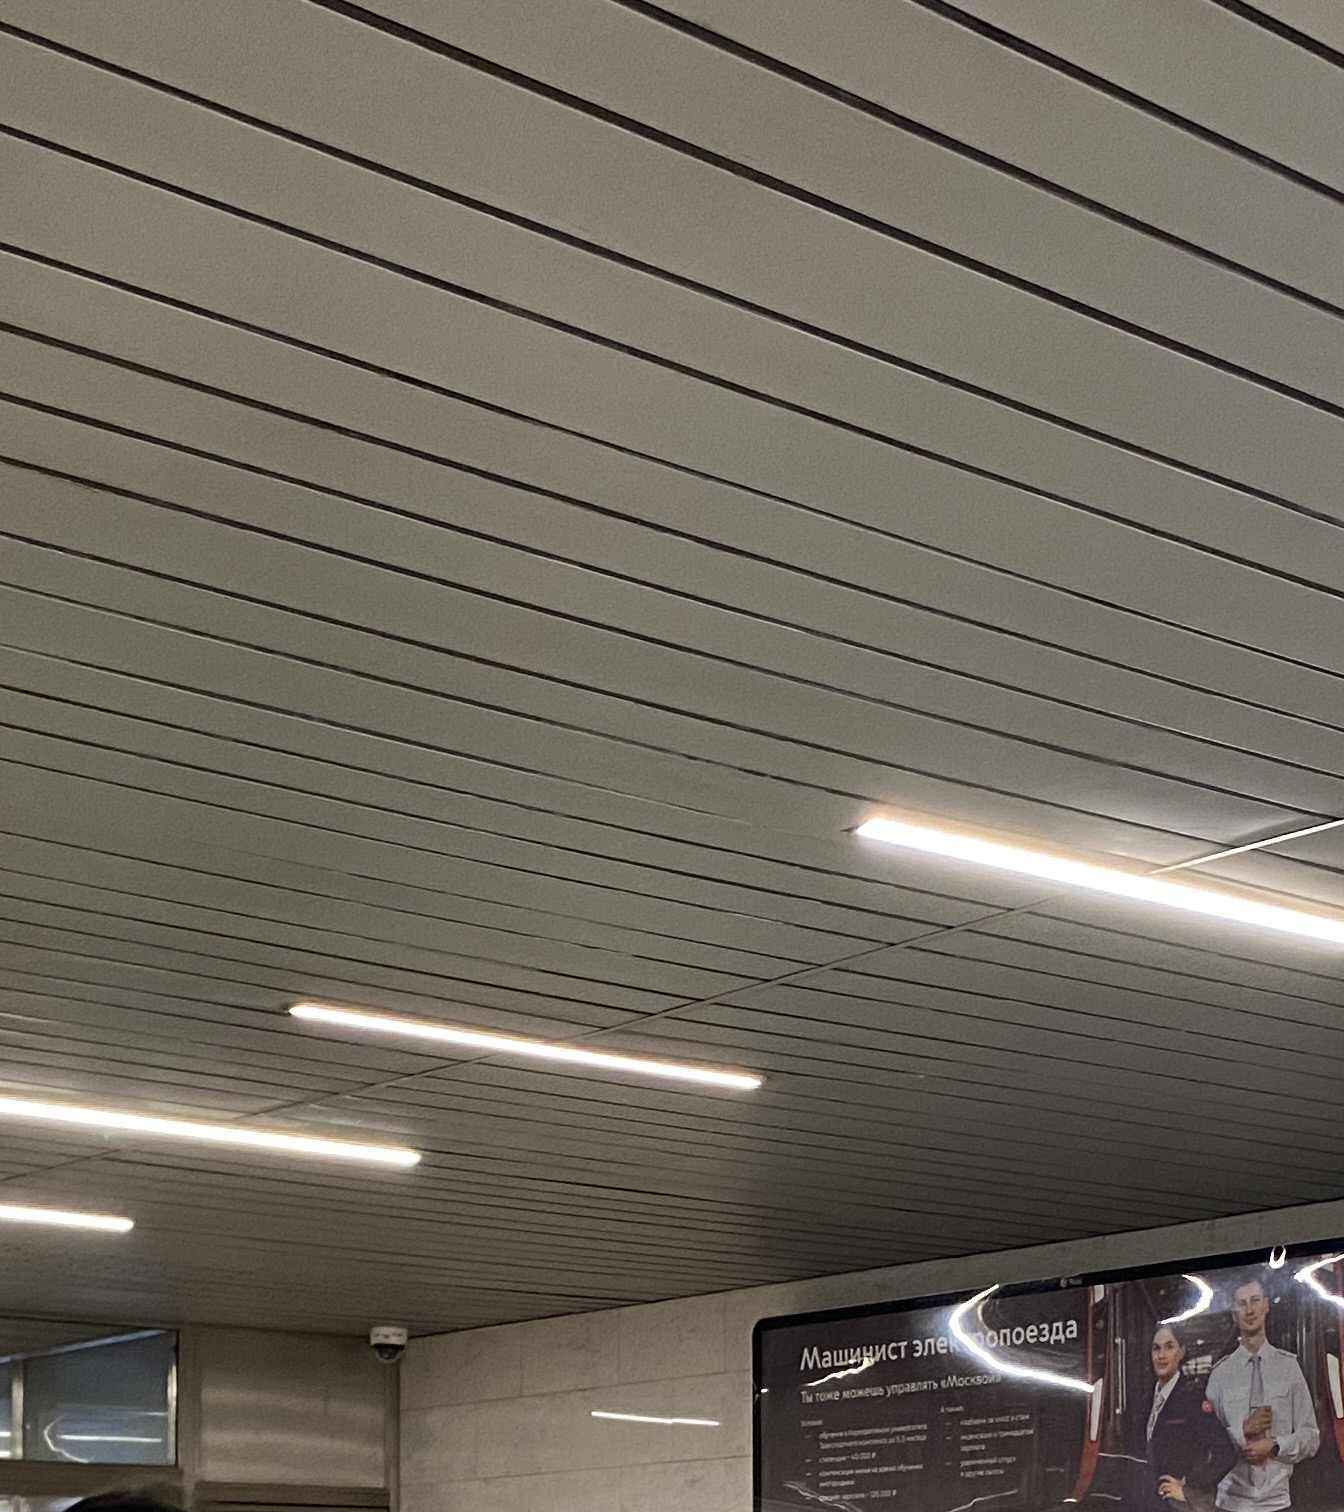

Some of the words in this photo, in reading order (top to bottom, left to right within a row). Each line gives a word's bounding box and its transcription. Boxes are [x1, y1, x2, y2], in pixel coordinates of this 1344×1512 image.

[800, 1341, 908, 1371] Машинист
[912, 1319, 1078, 1358] элекропоезда
[800, 1390, 813, 1403] Ты
[815, 1390, 840, 1401] тоже
[842, 1385, 884, 1399] можешь
[885, 1379, 938, 1398] управлять
